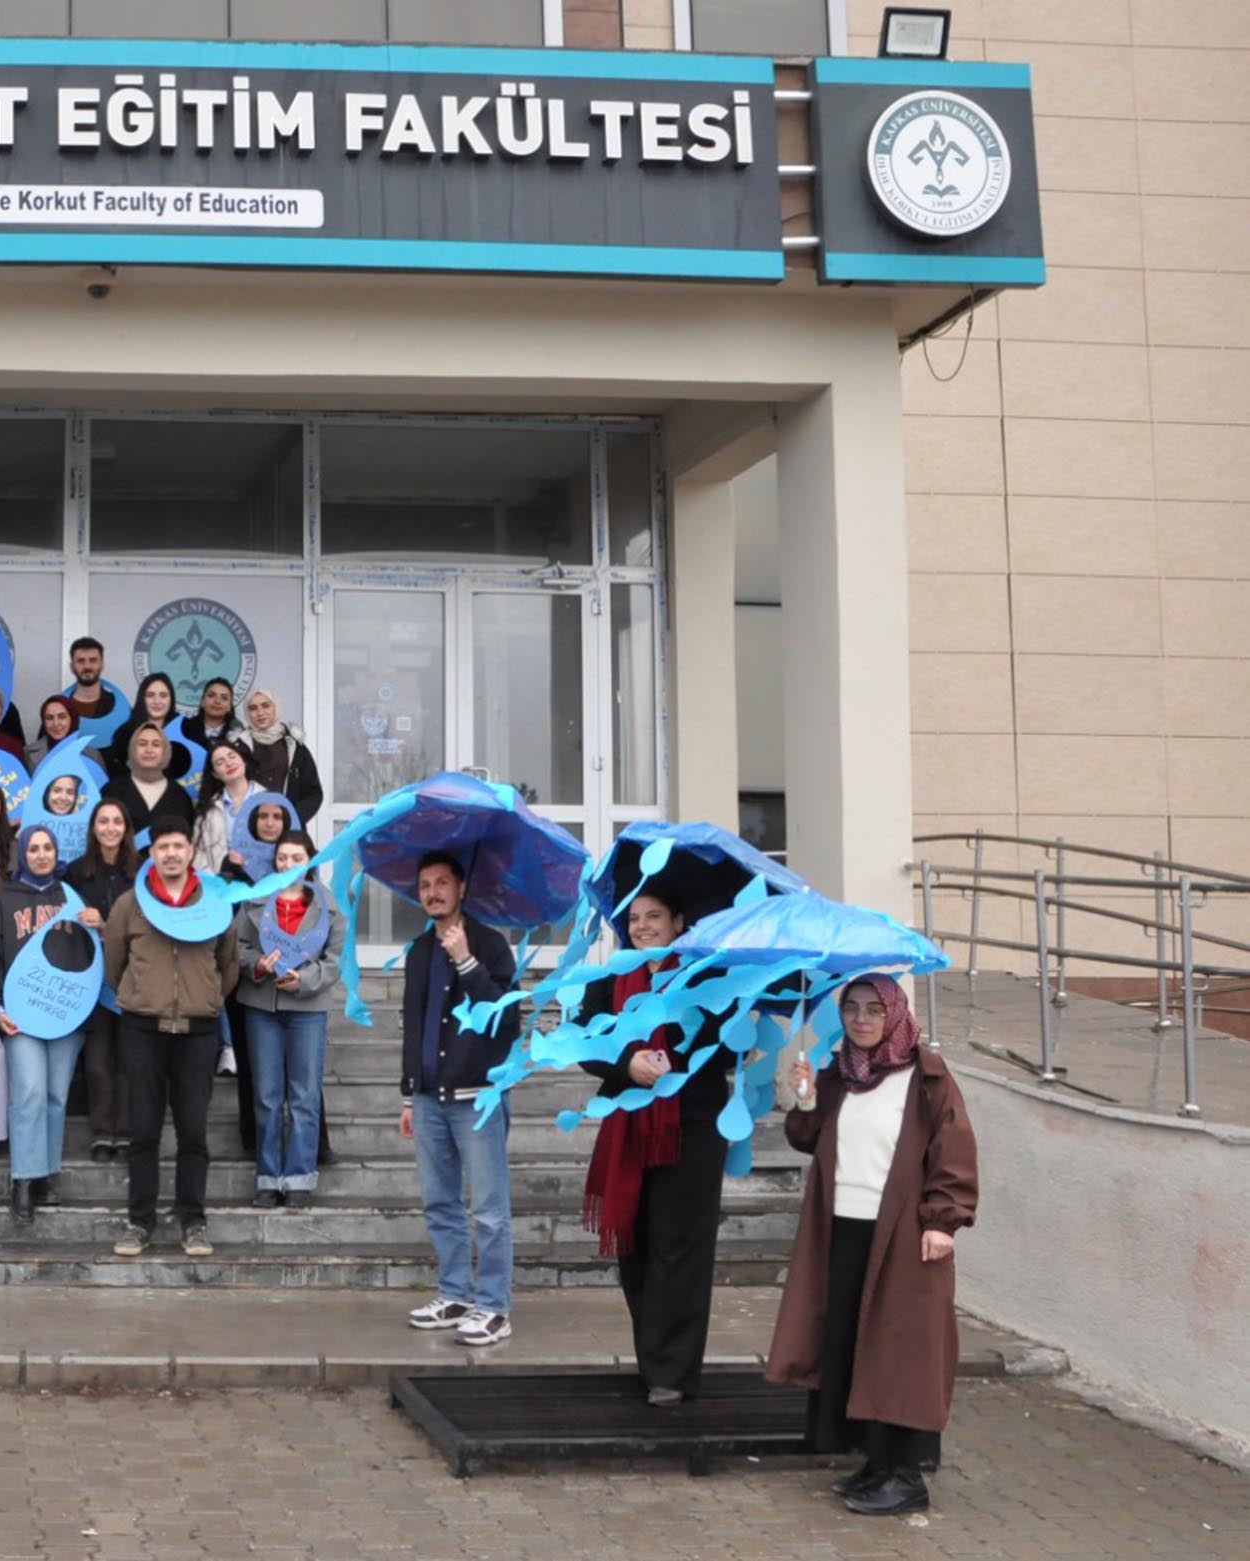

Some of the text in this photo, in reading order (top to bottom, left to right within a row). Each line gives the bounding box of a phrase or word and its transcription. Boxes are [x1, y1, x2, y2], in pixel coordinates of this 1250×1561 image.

[57, 73, 316, 150] EĞİTİM
[345, 82, 755, 164] FAKÜLTESİ
[881, 104, 919, 147] KAFKAS
[18, 190, 87, 211] Korkut
[93, 191, 167, 216] Faculty
[172, 193, 192, 212] of
[199, 194, 299, 215] Education
[27, 966, 89, 999] 22 MART
